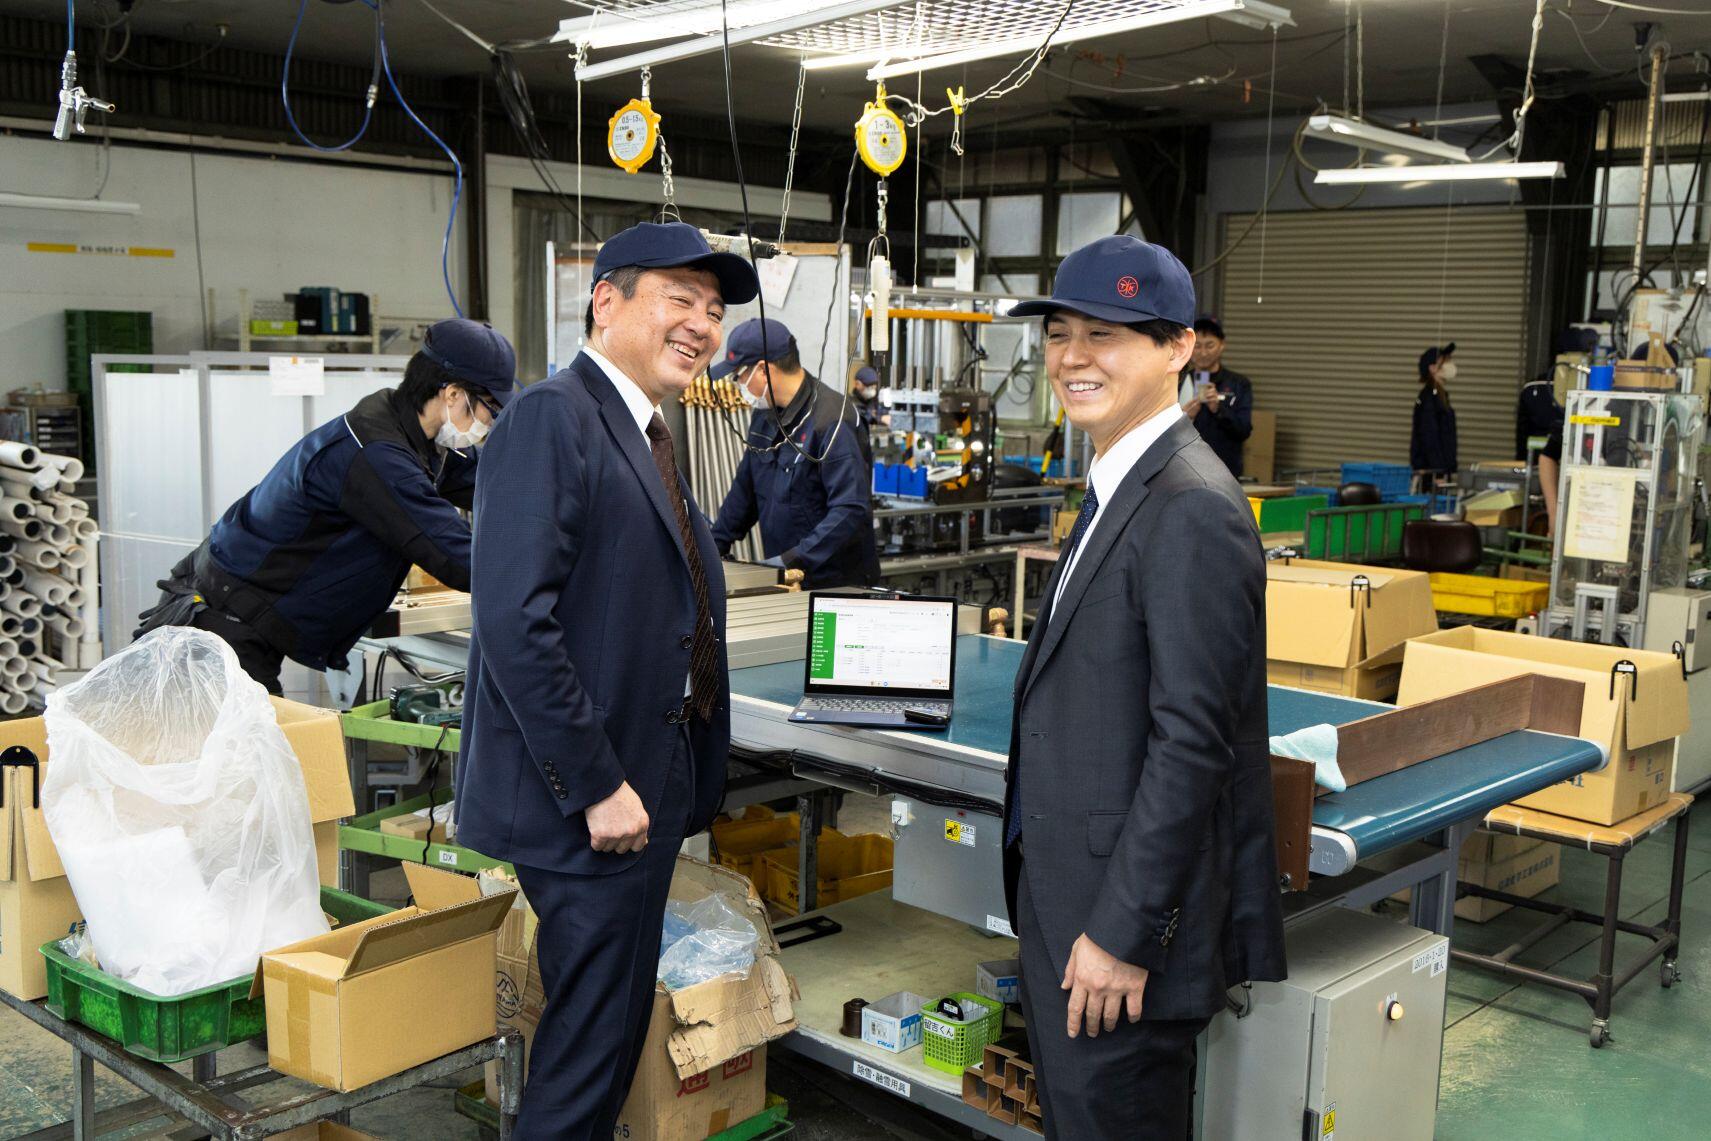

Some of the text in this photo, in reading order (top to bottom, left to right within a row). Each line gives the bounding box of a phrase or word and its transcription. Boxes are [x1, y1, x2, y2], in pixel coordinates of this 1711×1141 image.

[443, 853, 453, 863] DX
[924, 1019, 954, 1038] 留吉くん
[856, 1064, 906, 1094] 除雪・融雪用具
